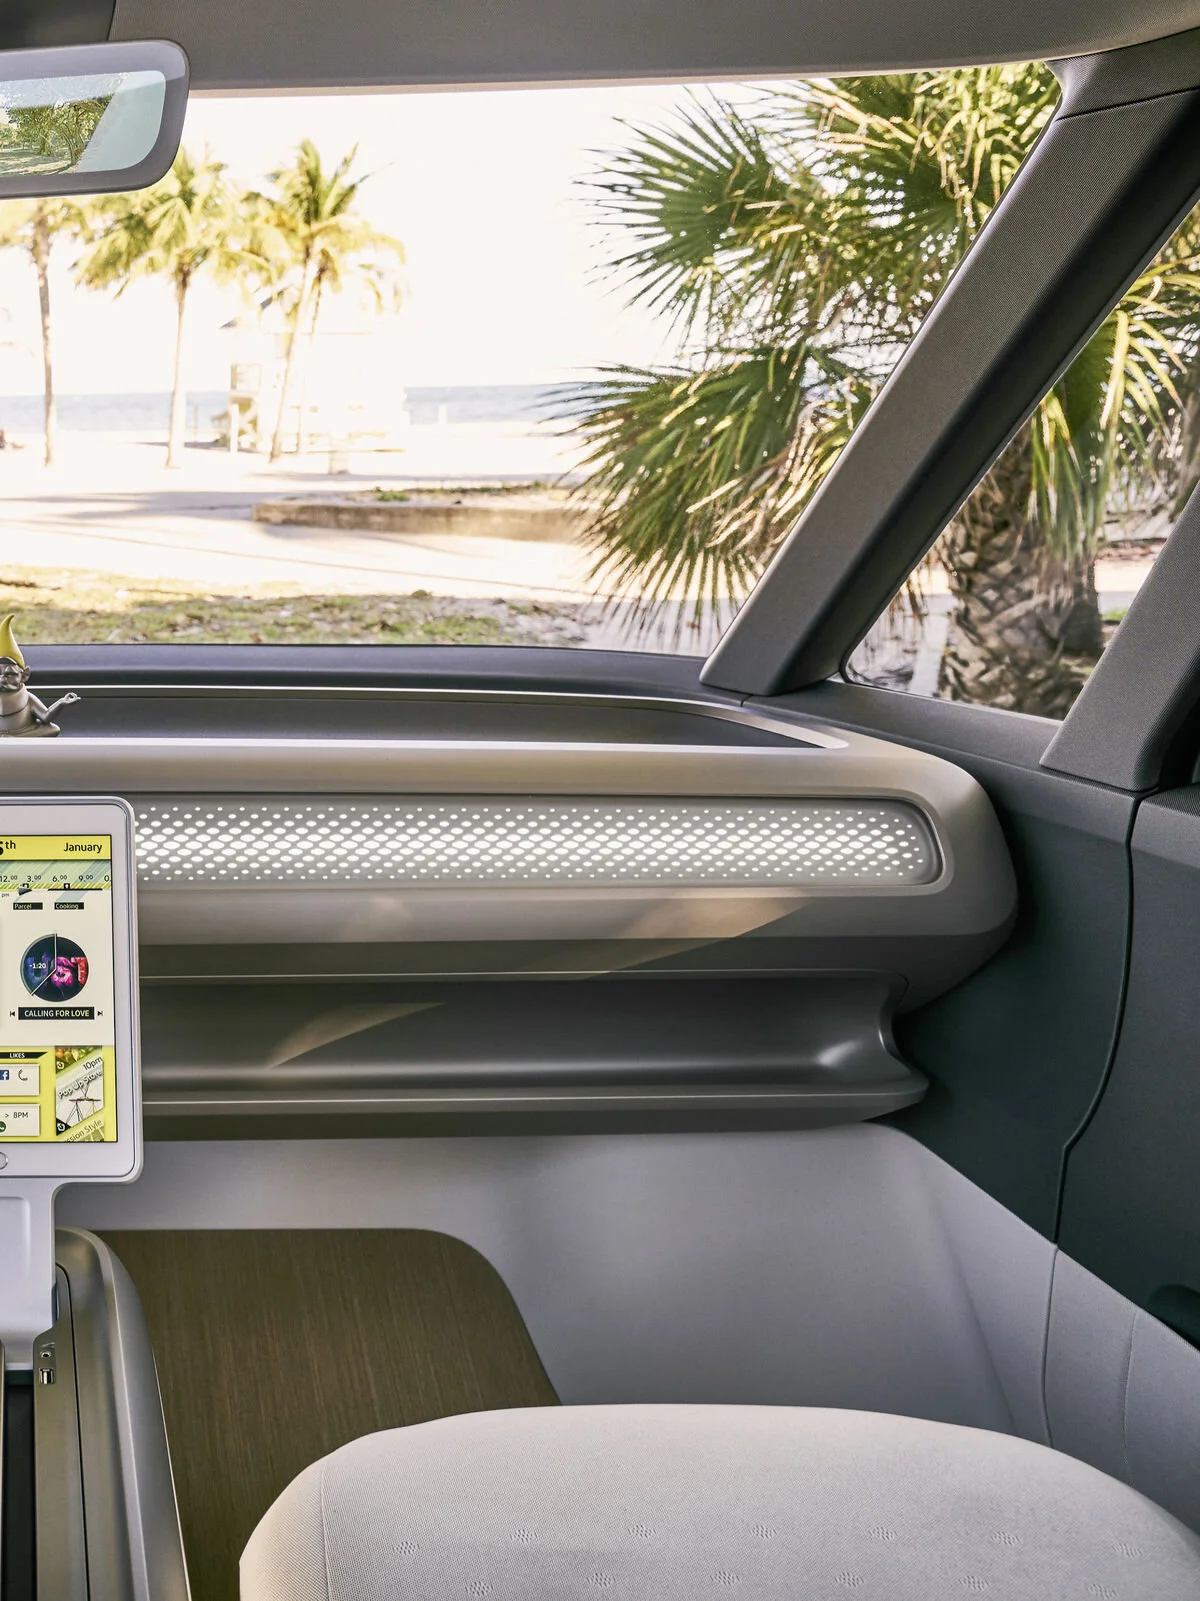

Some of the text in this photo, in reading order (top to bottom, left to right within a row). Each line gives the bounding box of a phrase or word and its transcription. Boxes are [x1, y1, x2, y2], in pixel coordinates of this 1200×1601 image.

[64, 843, 102, 854] January
[83, 1057, 103, 1070] 10pm
[58, 1088, 73, 1099] Pop
[84, 1119, 103, 1133] Style
